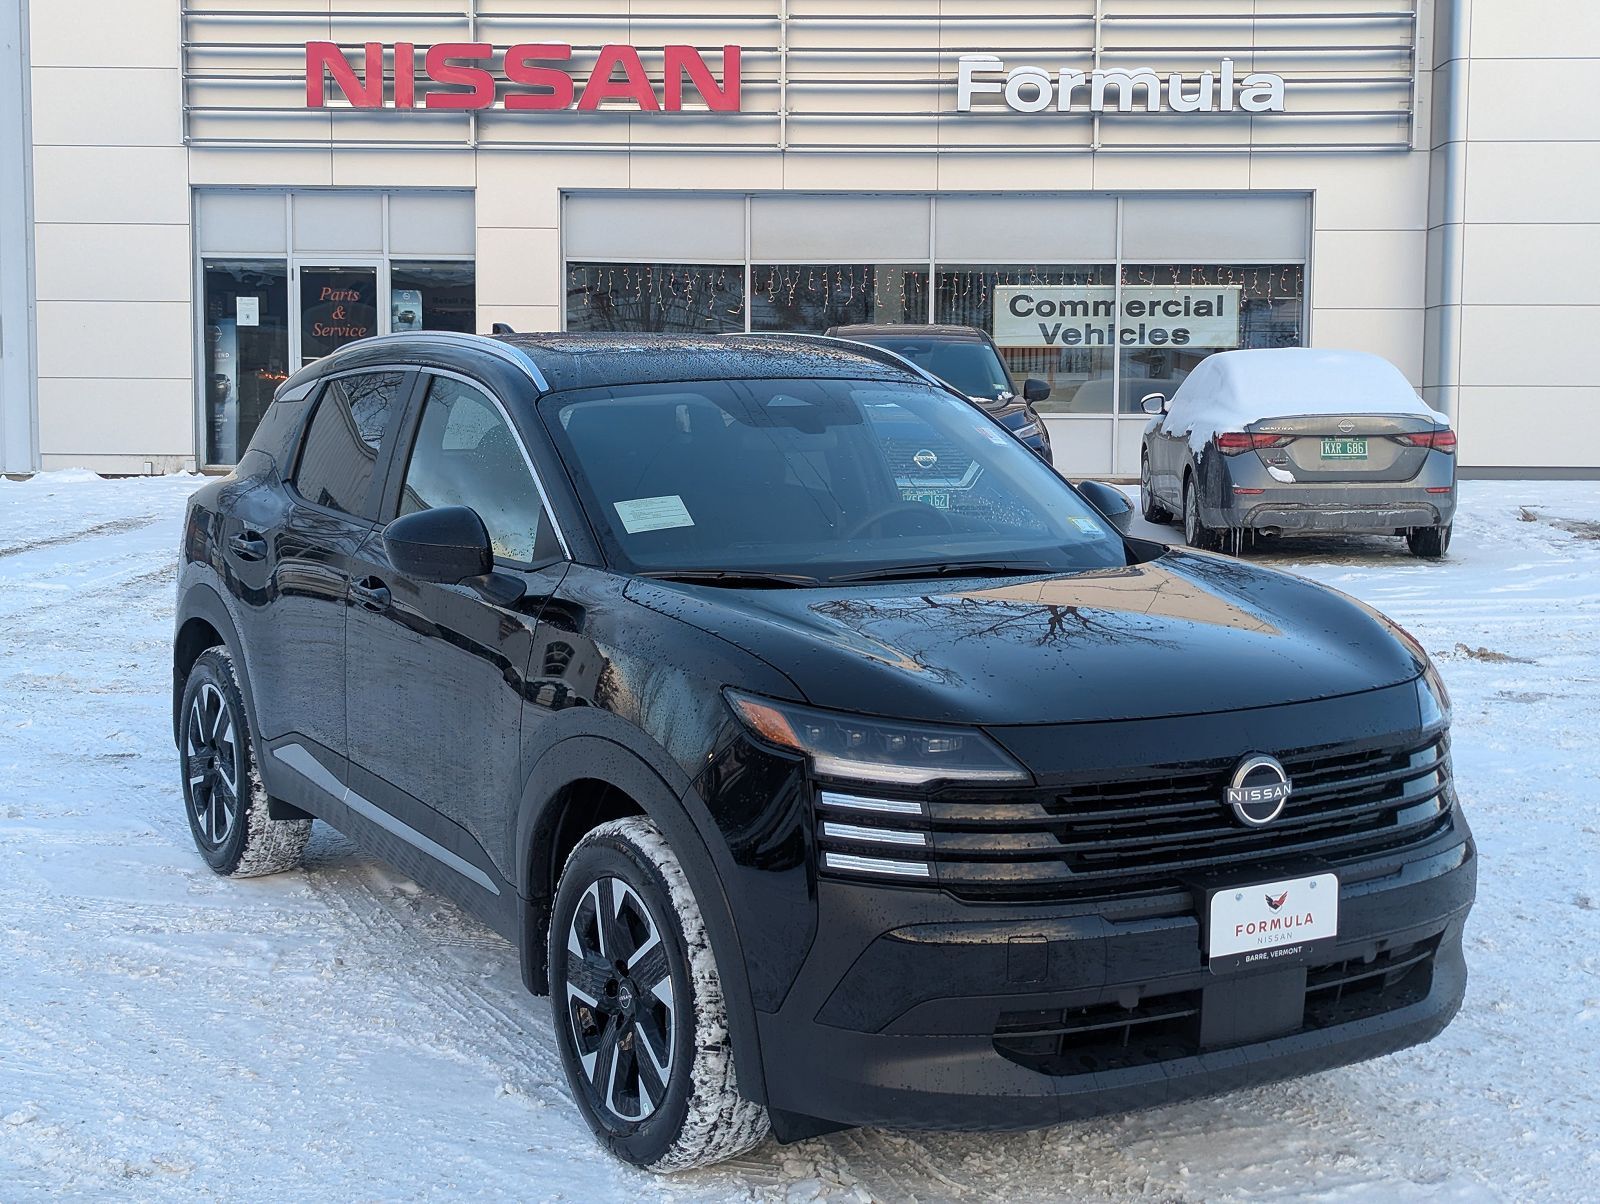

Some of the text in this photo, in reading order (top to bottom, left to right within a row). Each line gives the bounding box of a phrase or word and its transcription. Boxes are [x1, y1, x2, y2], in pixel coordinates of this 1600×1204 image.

[306, 42, 741, 111] NISSAN
[957, 58, 1286, 113] Formula
[319, 287, 360, 301] Parts
[332, 305, 346, 320] &
[1008, 294, 1224, 317] Commercial
[312, 322, 367, 337] Service
[1038, 322, 1191, 346] Vehicles
[1324, 442, 1364, 454] KXR 686
[1230, 783, 1292, 801] NISSAN
[1235, 912, 1314, 937] FORMULA
[1257, 932, 1293, 945] NISSAN
[1245, 946, 1303, 963] BARRE, VERMONT
